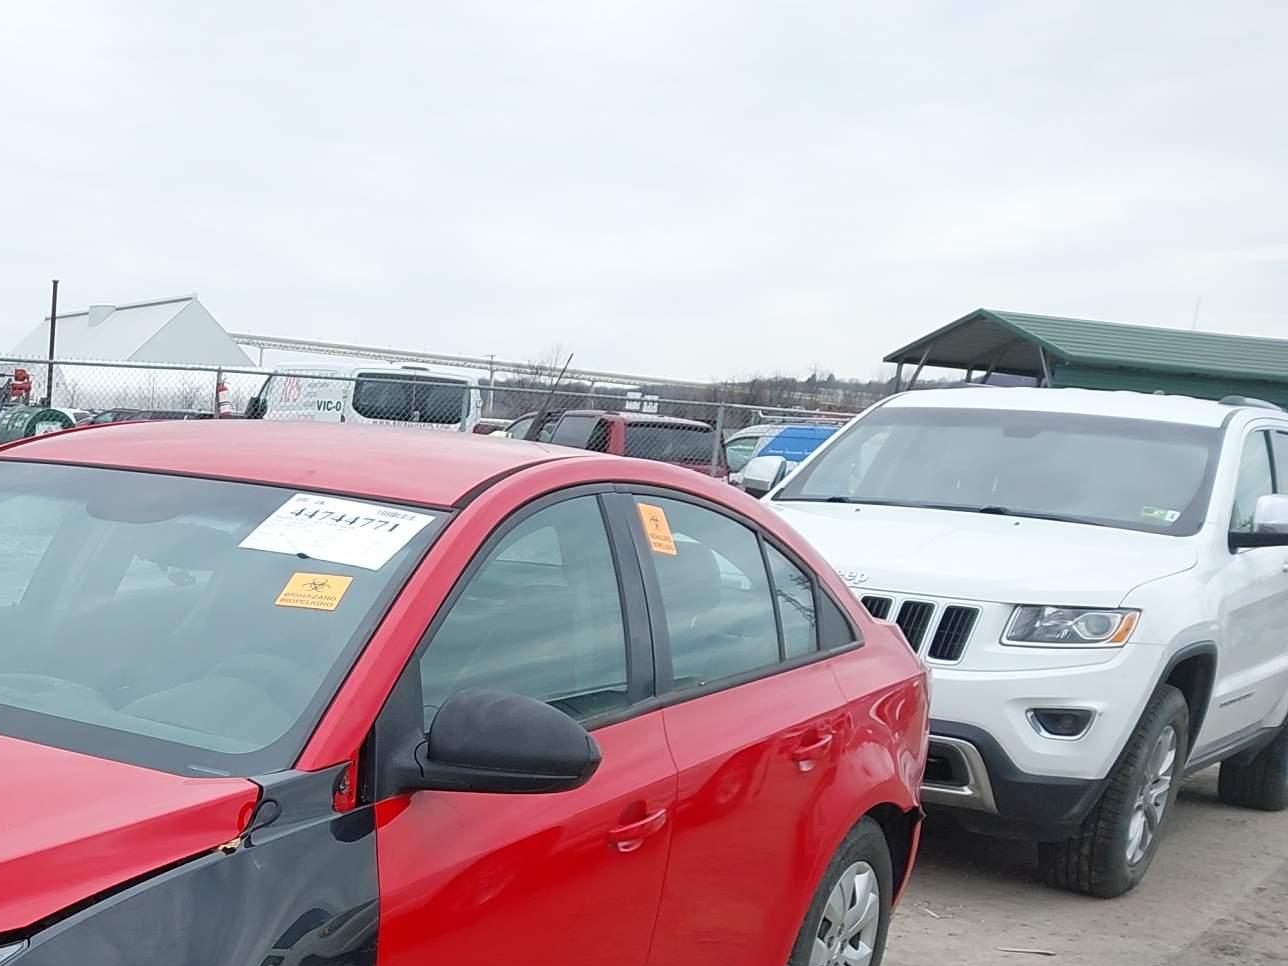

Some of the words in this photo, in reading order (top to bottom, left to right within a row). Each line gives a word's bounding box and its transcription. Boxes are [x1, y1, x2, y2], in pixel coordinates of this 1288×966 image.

[290, 507, 401, 532] 44744771
[837, 568, 870, 584] eep
[279, 598, 334, 608] BIOPELIGRO
[283, 592, 337, 601] BIOHAZARD
